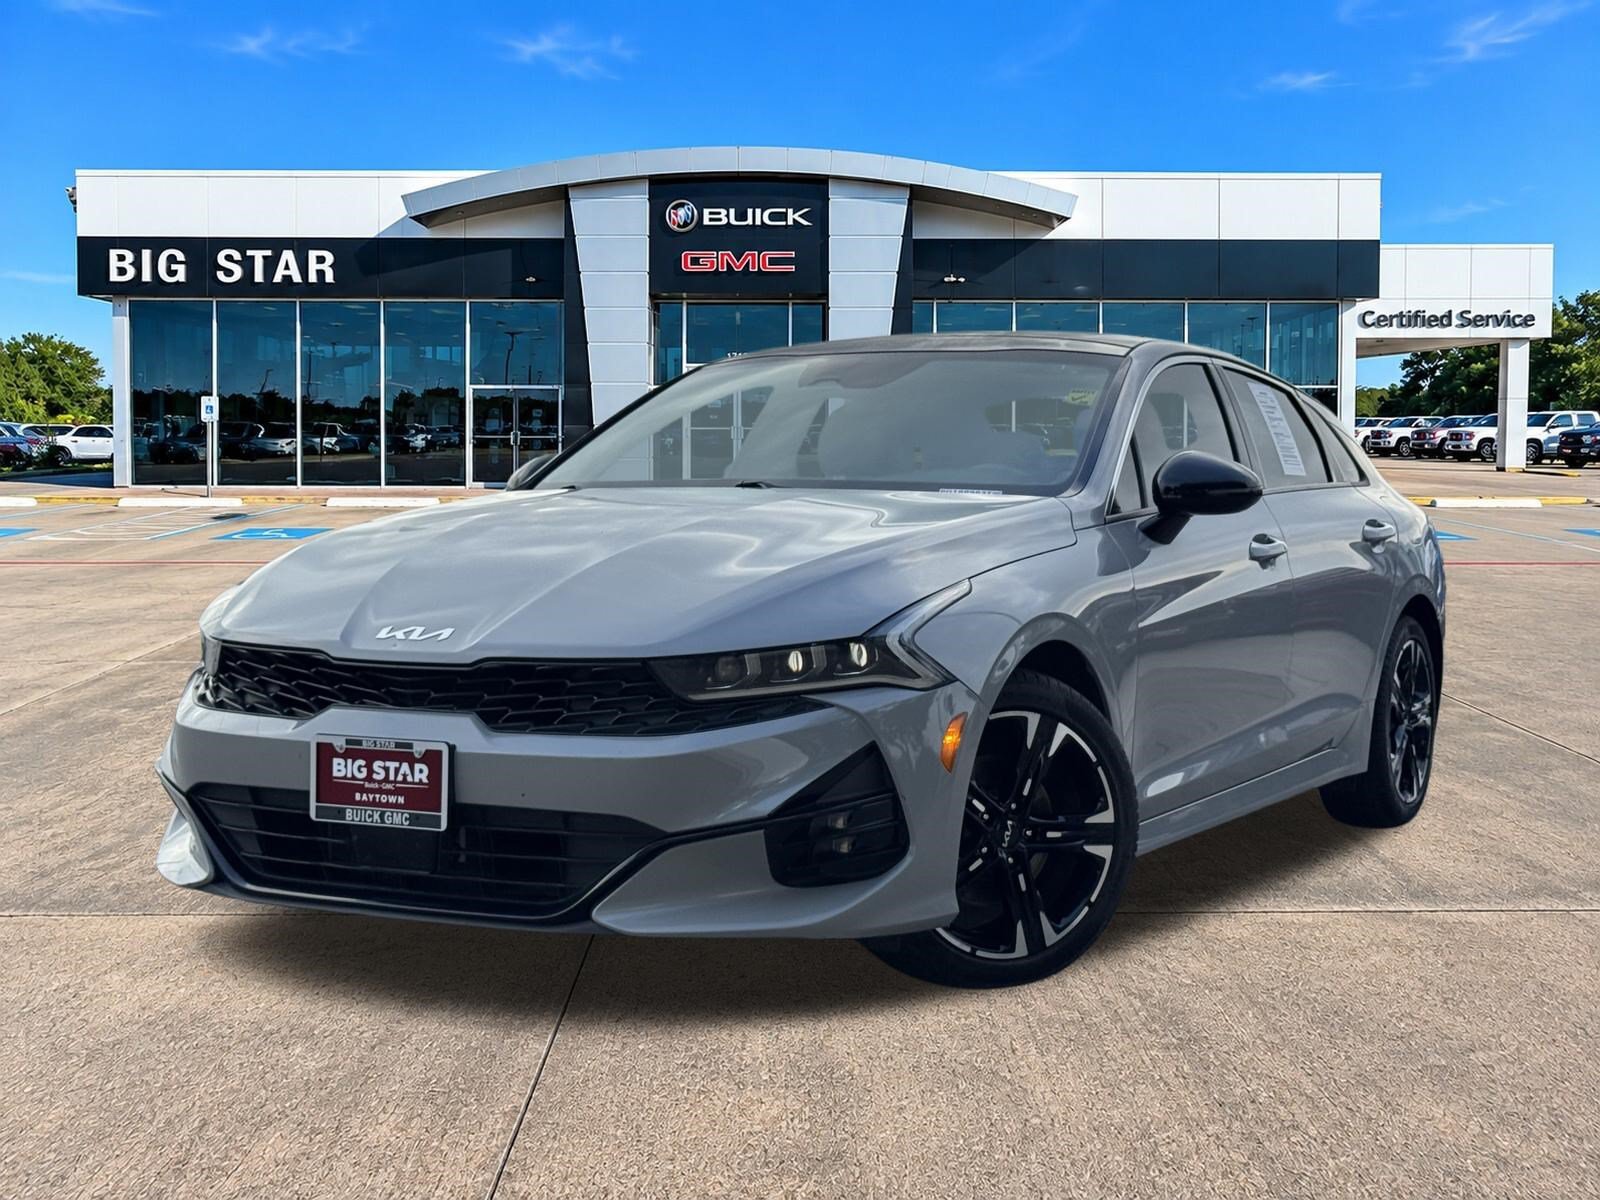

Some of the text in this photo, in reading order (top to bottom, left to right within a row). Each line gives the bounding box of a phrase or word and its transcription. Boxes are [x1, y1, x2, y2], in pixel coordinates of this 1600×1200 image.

[702, 207, 814, 226] BUICK
[108, 248, 336, 284] BIG STAR
[681, 251, 796, 272] GMC
[1359, 310, 1536, 329] Certified Service
[375, 625, 456, 641] KIA
[362, 739, 396, 749] BIG STAR
[332, 757, 429, 783] BIG STAR
[355, 792, 405, 804] BAYTOWN
[345, 808, 410, 825] BUICK GMC
